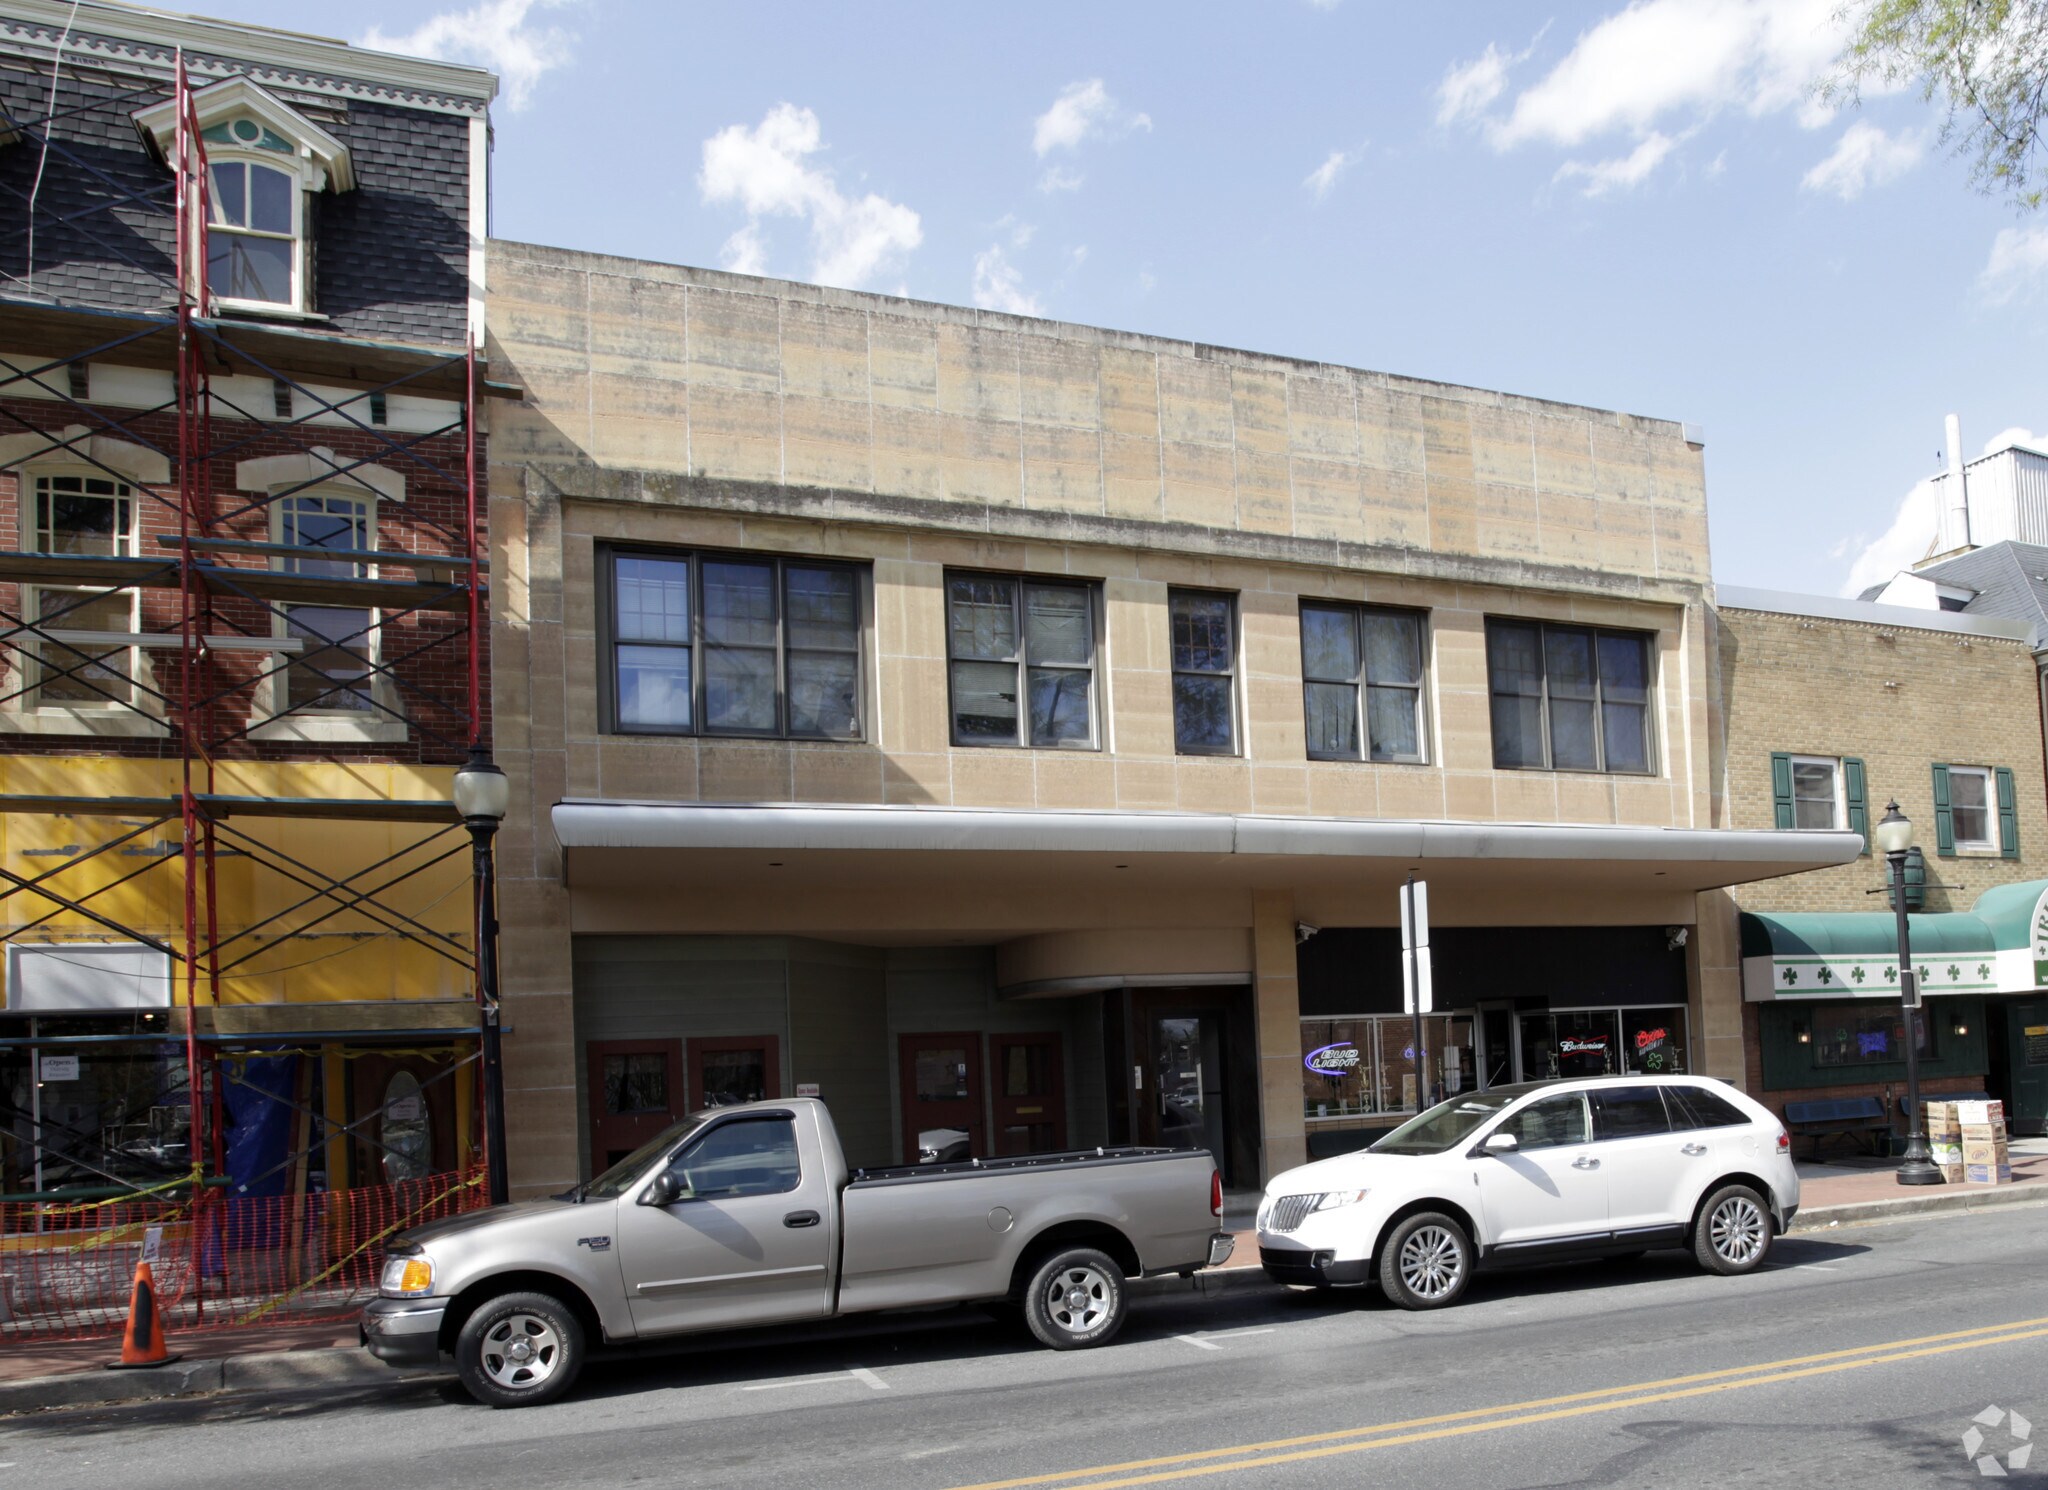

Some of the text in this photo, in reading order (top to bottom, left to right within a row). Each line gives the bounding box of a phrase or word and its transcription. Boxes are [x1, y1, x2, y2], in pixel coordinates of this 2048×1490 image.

[1559, 1041, 1606, 1052] Budweiser
[1321, 1050, 1359, 1059] BUD
[1311, 1058, 1360, 1068] LIGHT
